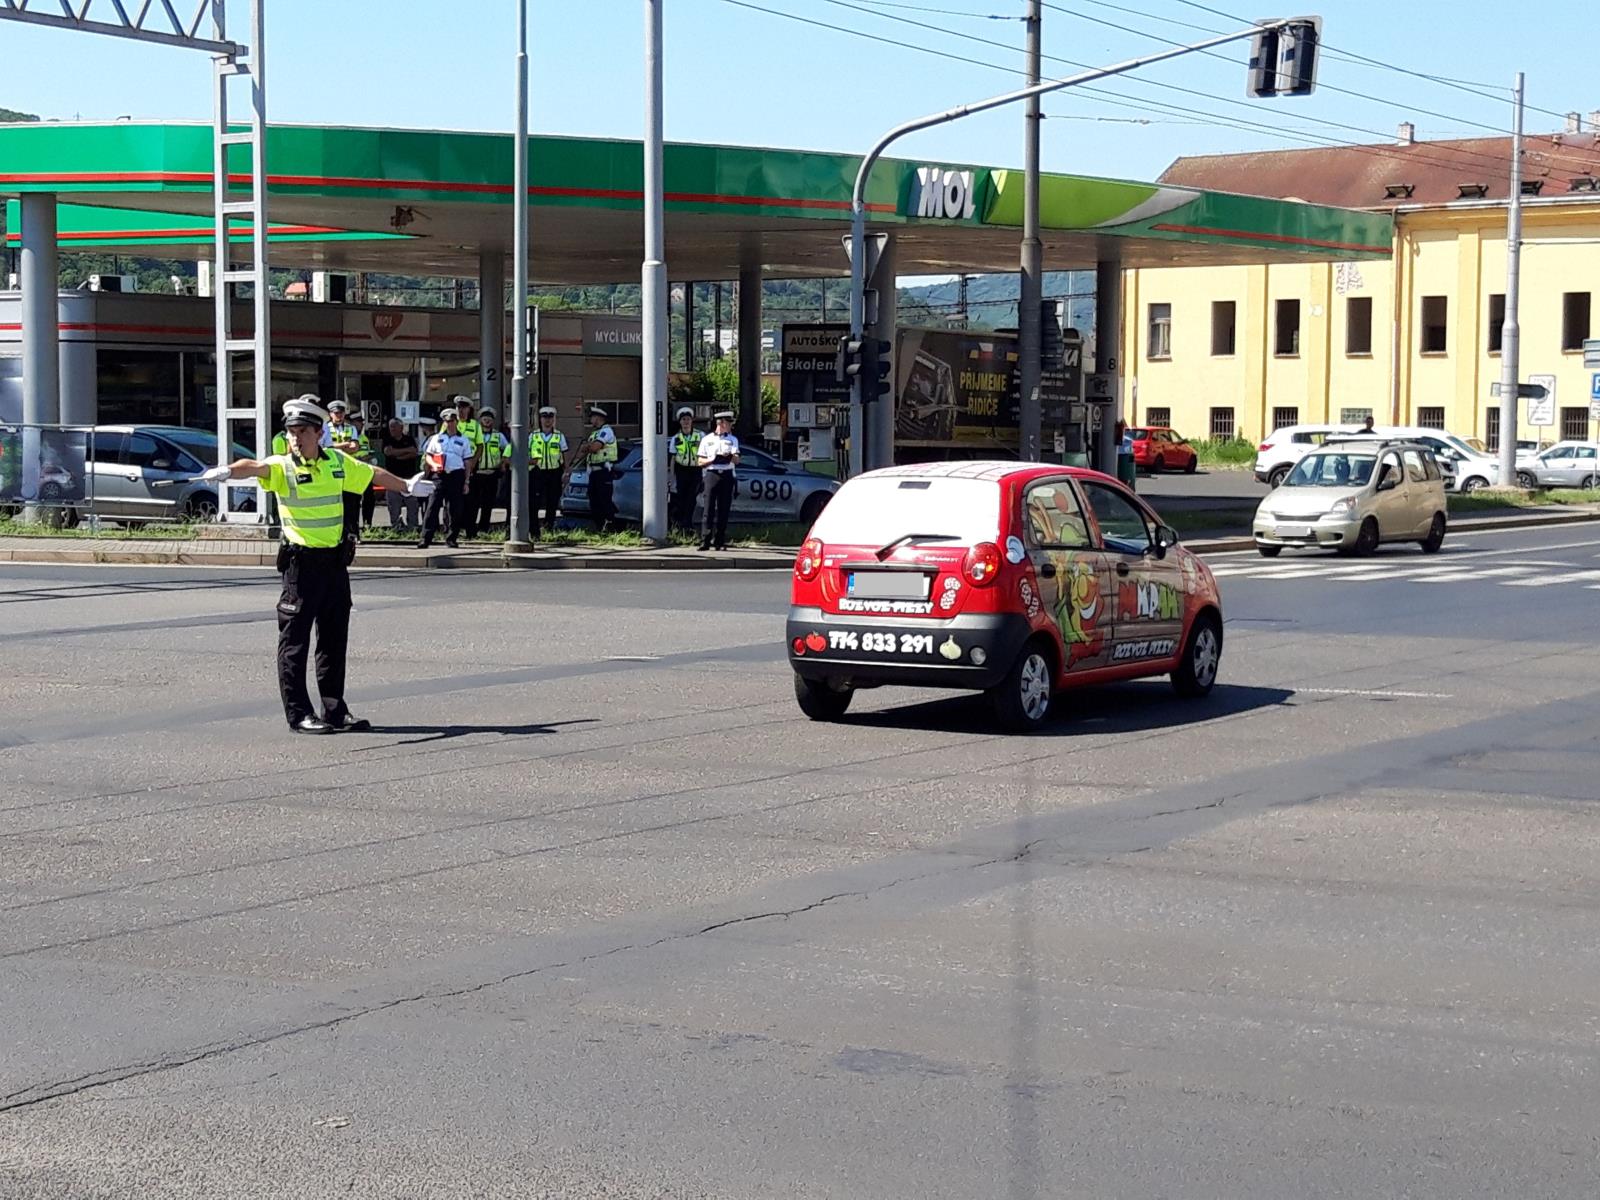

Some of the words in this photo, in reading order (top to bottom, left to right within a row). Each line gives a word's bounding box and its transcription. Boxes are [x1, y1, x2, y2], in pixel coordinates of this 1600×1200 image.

[917, 167, 976, 219] MOL
[620, 331, 642, 344] LINK
[790, 334, 839, 346] AUTOŠKO
[487, 368, 496, 381] 2
[750, 480, 792, 500] 980
[828, 631, 858, 650] 774
[862, 632, 896, 652] 833
[900, 634, 933, 654] 291
